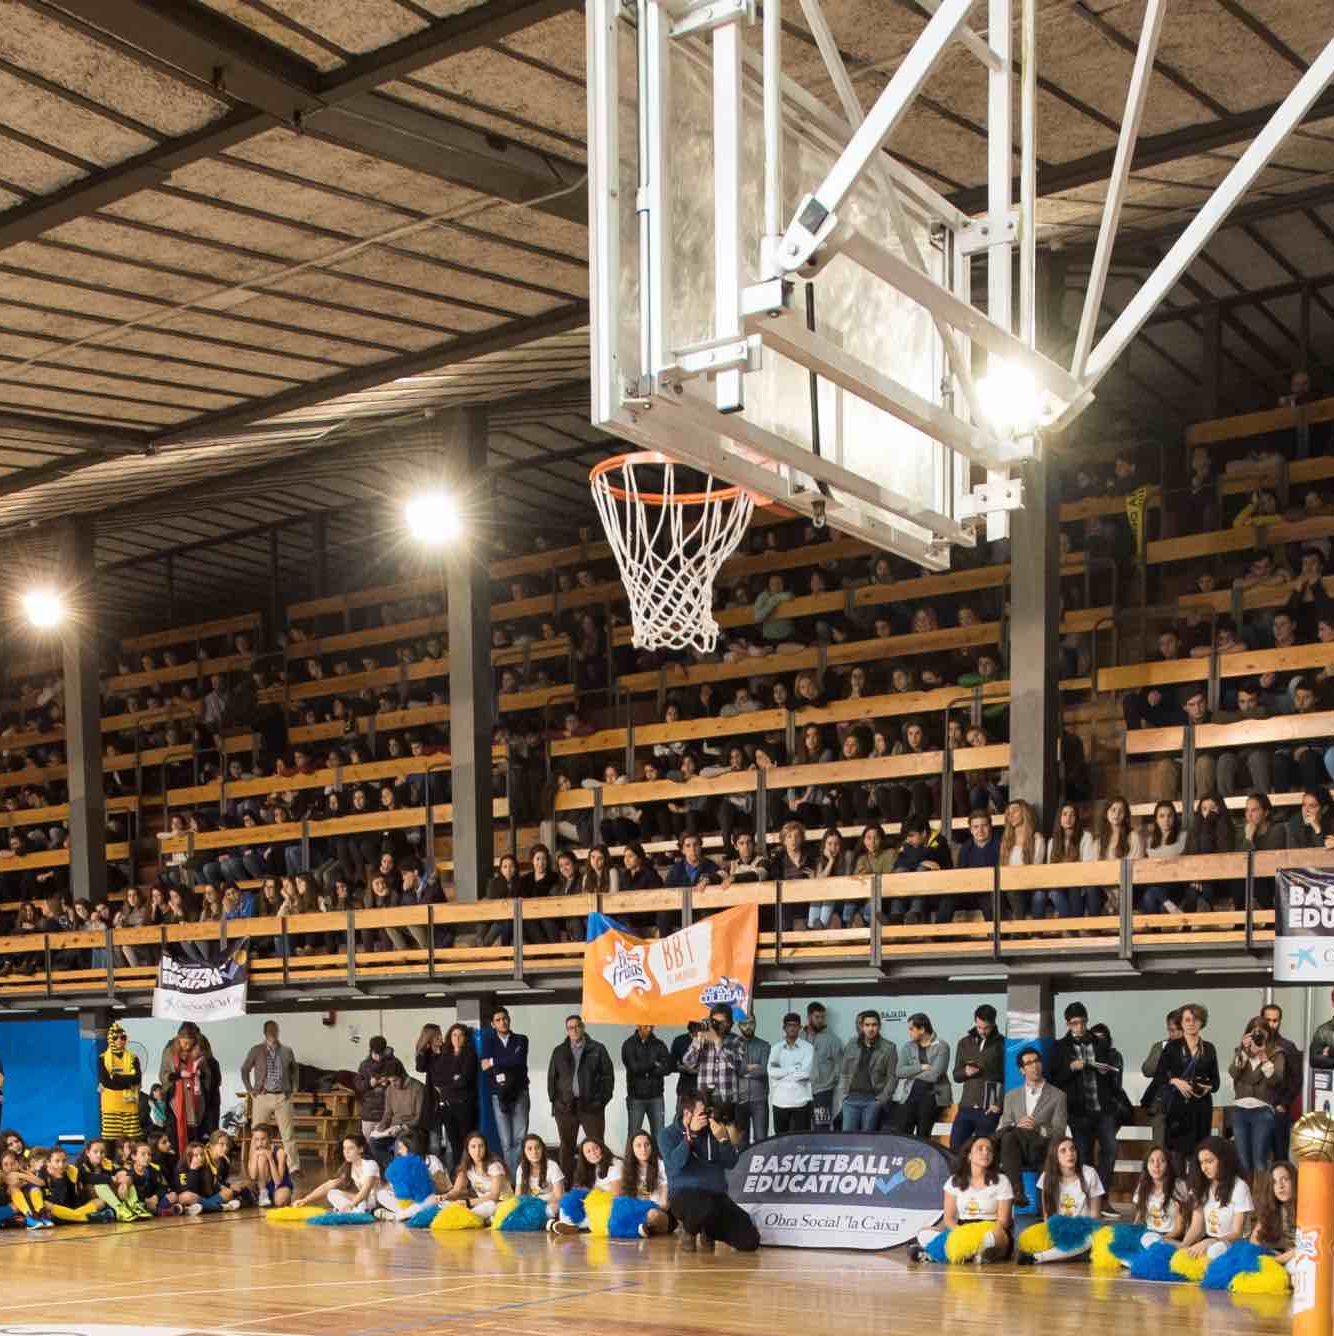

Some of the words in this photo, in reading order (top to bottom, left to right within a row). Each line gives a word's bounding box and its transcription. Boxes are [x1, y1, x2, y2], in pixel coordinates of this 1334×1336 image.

[749, 1153, 890, 1175] BASKETBALL
[891, 1156, 903, 1167] IS
[742, 1175, 876, 1196] EDUCATION
[764, 1212, 798, 1228] Obra
[800, 1213, 840, 1229] Social
